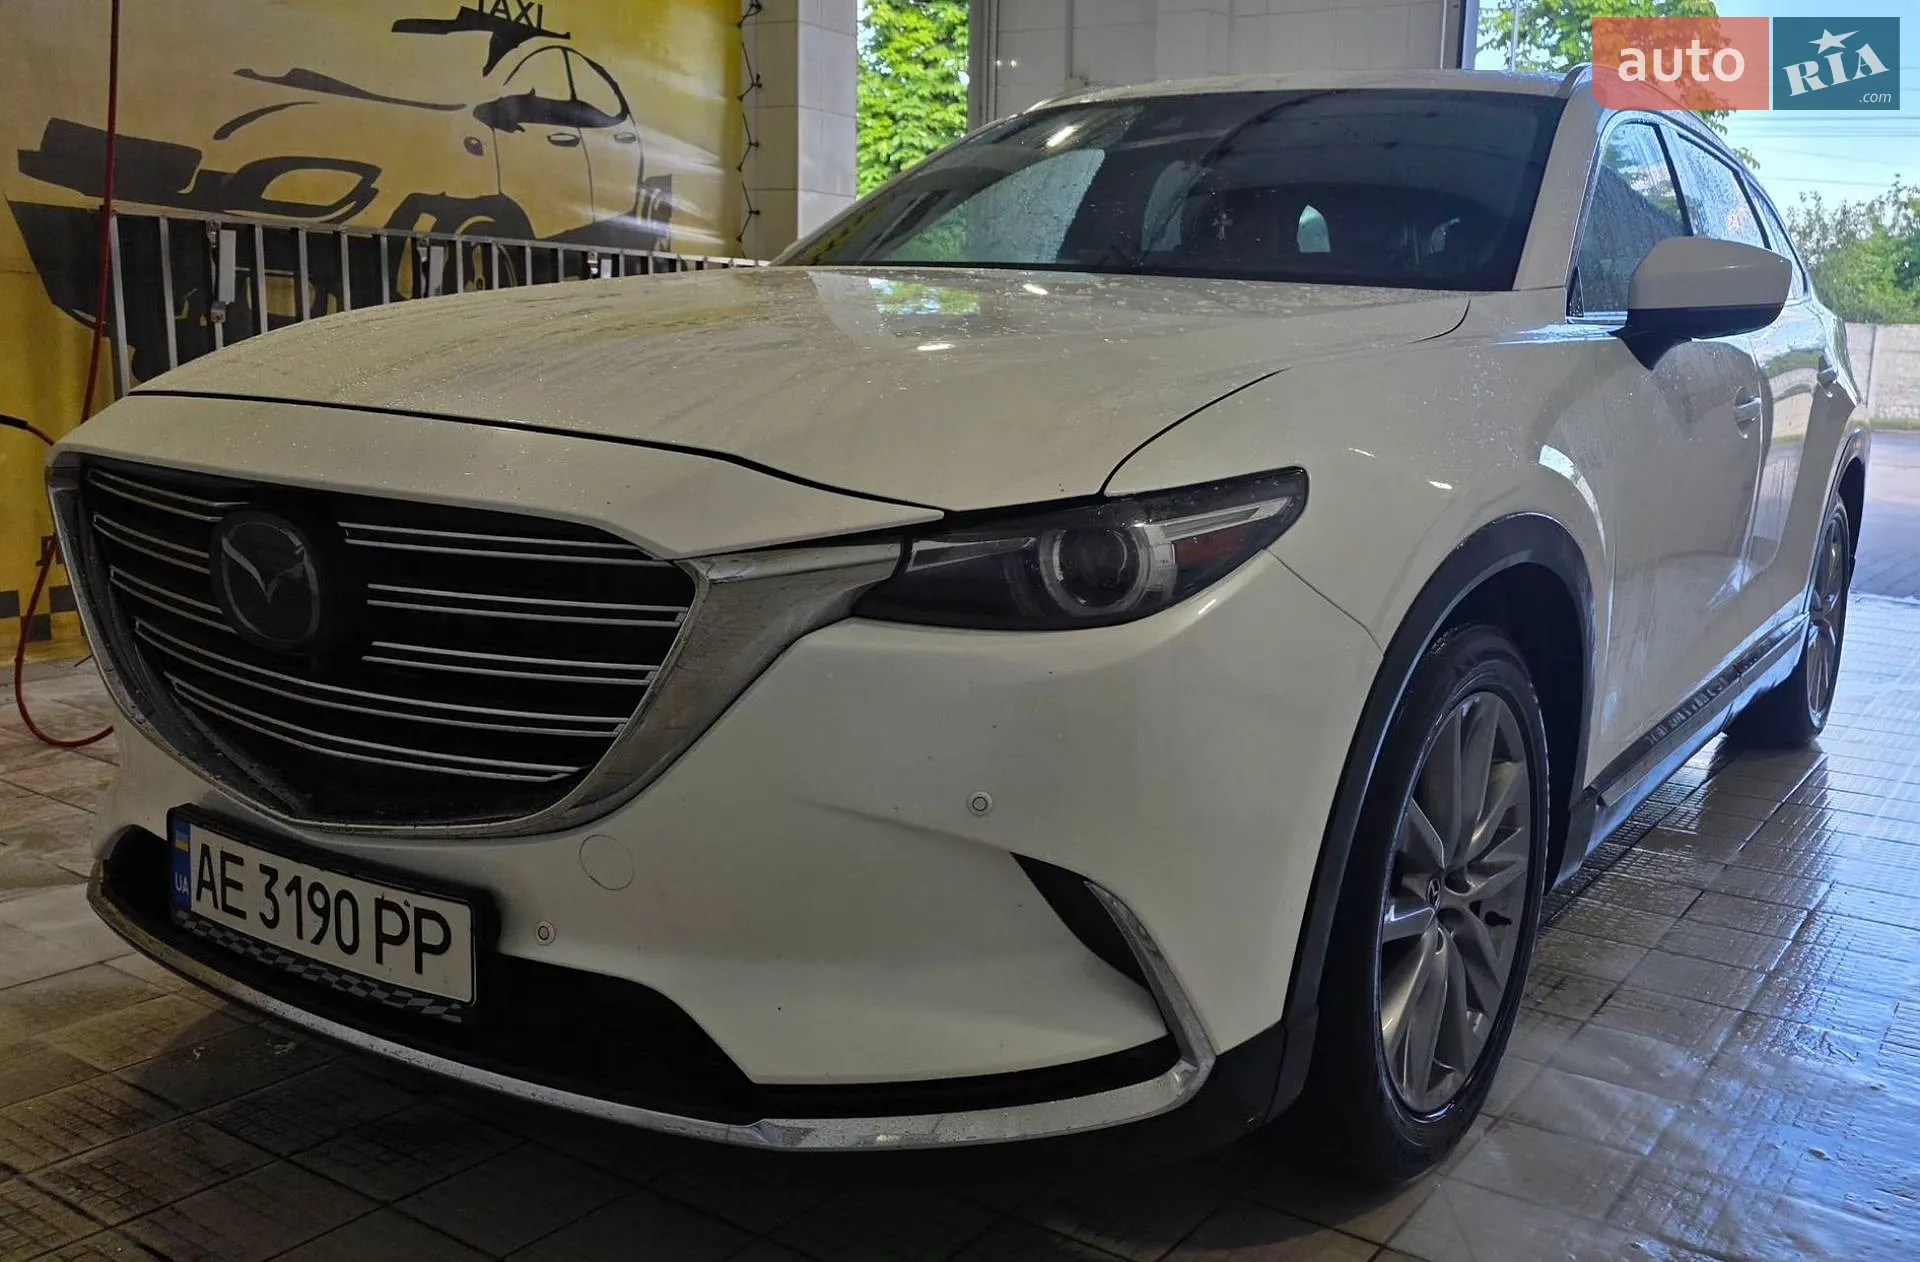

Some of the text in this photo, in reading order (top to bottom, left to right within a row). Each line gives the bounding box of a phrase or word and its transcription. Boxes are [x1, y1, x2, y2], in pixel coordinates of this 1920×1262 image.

[174, 871, 190, 896] UA
[196, 843, 452, 975] AE 3190 PP
